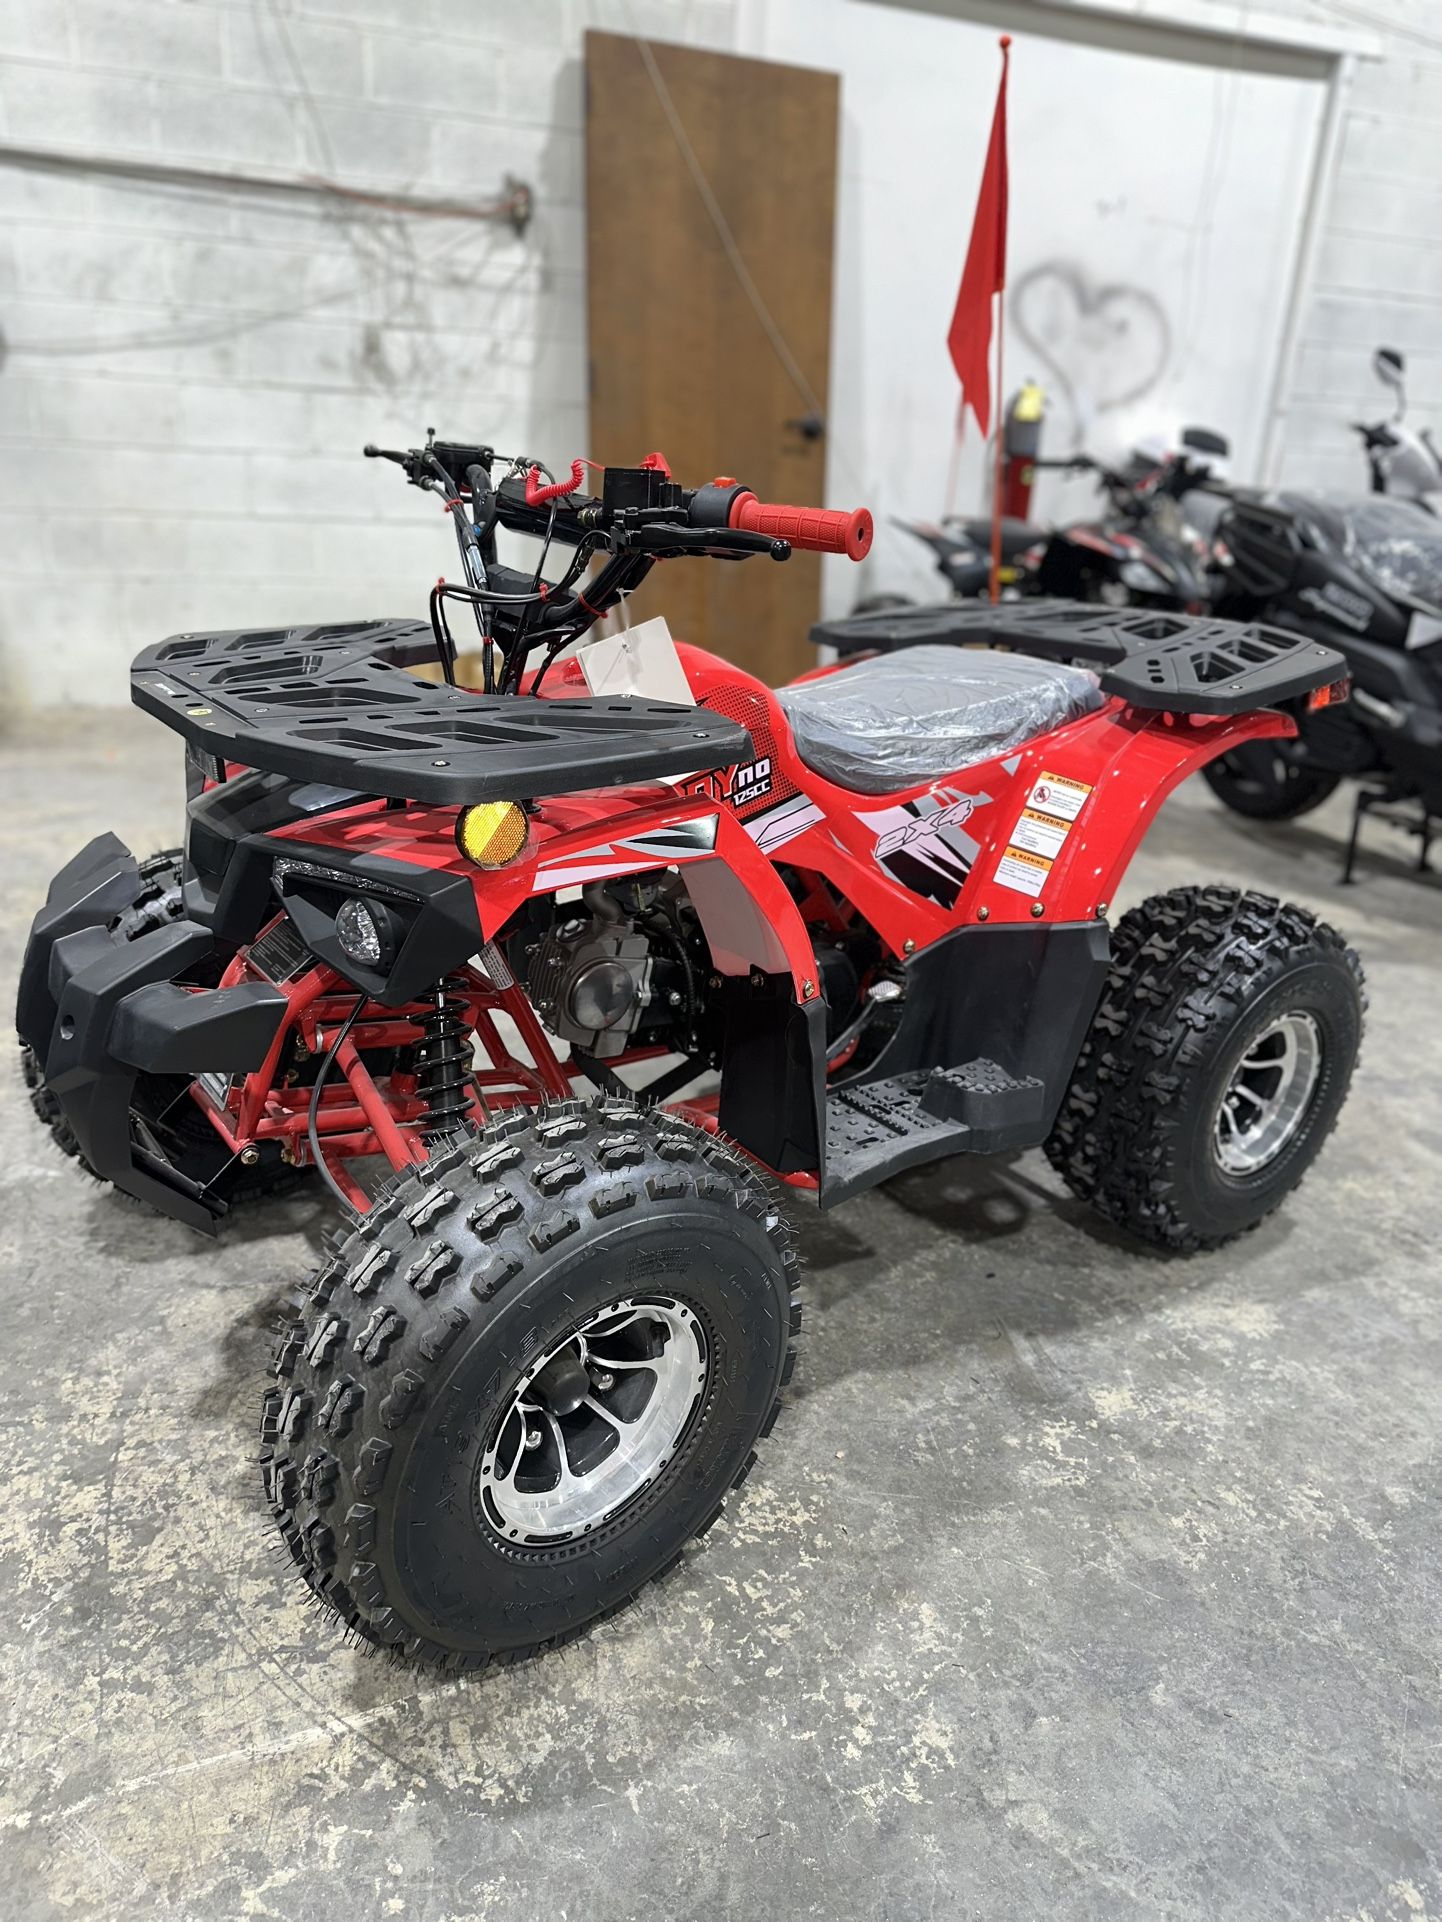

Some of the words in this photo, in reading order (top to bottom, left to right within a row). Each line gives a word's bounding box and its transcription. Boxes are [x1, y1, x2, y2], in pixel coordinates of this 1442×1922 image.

[1056, 777, 1085, 790] WARNING
[733, 779, 770, 807] 125CC
[1036, 815, 1065, 828] WARNING
[1018, 854, 1045, 867] WARNING
